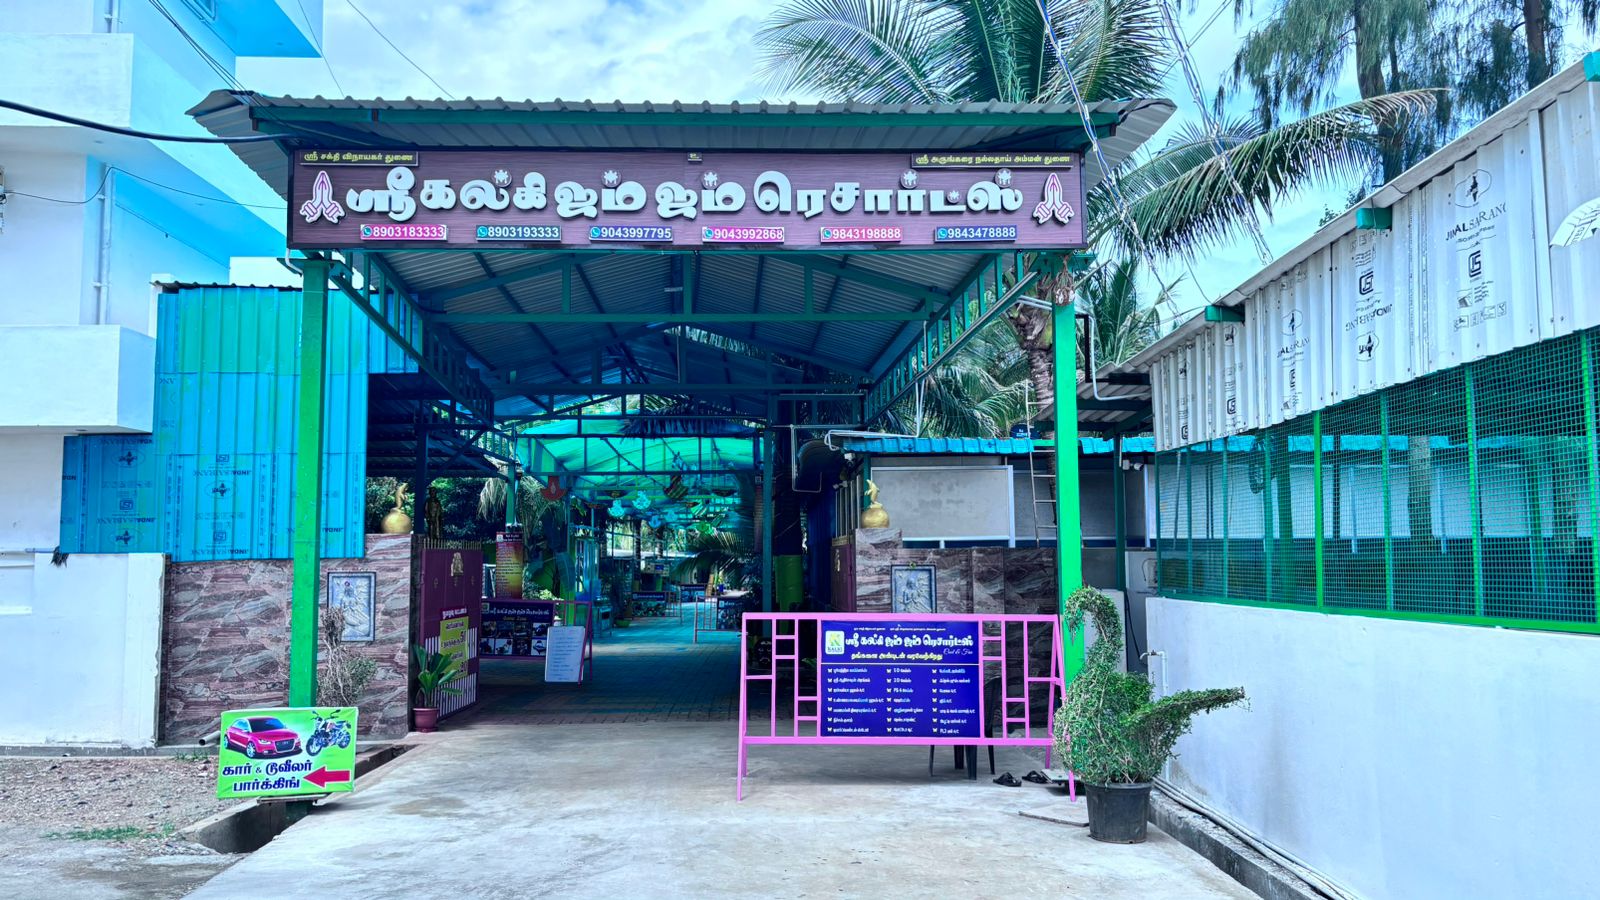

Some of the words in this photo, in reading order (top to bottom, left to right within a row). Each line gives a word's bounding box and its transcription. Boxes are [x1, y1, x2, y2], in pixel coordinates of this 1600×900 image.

[419, 168, 548, 212] கல்கி
[553, 169, 648, 220] ஜம்
[654, 169, 747, 220] ஜம்
[373, 225, 446, 238] 8903183333
[487, 225, 560, 238] 8903193333
[601, 226, 672, 239] 9043997795
[713, 227, 784, 240] 9043992868
[832, 227, 902, 239] 9843198888
[947, 226, 1016, 239] 9843478888
[222, 762, 251, 776] கார்
[266, 759, 313, 777] டூவீலர்
[233, 777, 300, 792] பார்க்கிங்
